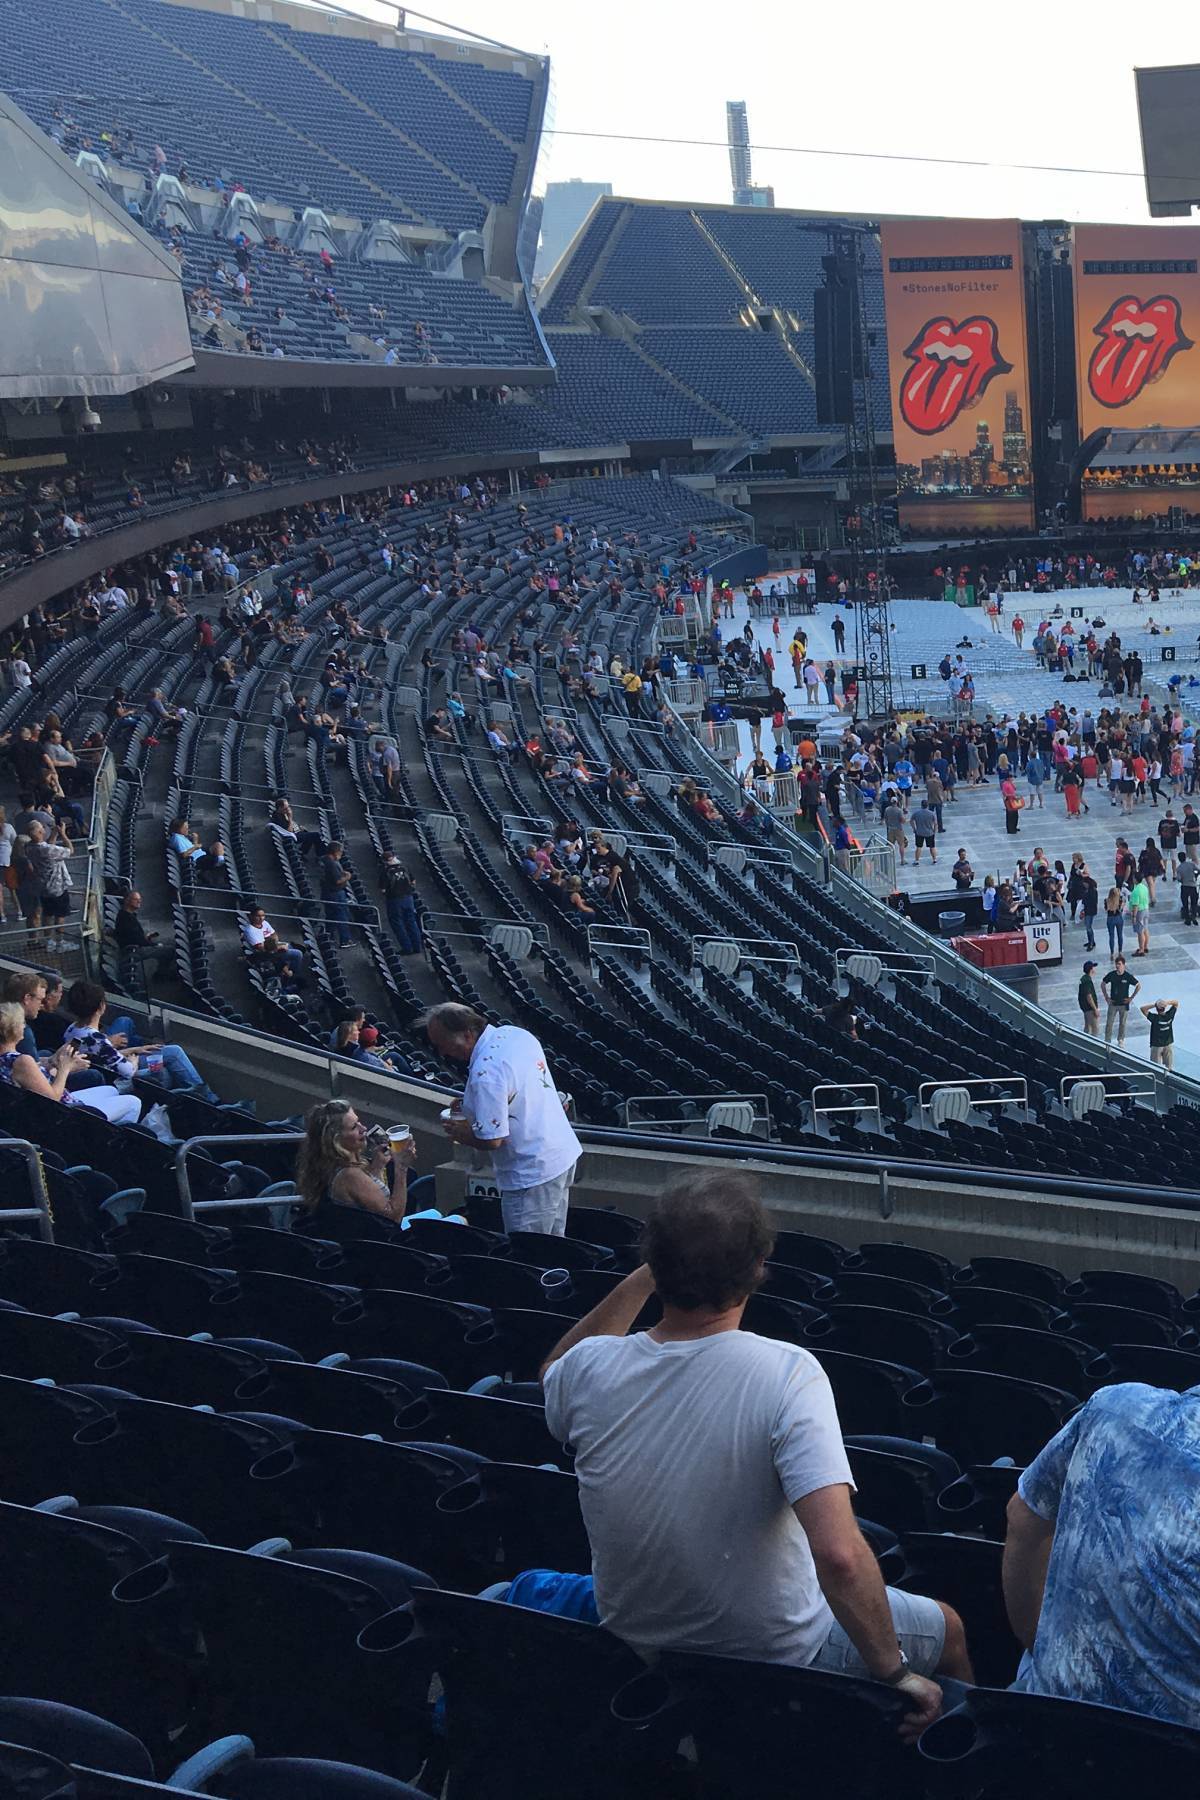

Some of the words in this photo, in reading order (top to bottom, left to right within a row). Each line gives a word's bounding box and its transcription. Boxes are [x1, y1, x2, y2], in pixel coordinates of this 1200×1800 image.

[1073, 609, 1080, 617] D
[1165, 649, 1172, 659] G
[857, 669, 863, 679] E
[915, 666, 922, 677] E
[1032, 927, 1051, 939] Lite
